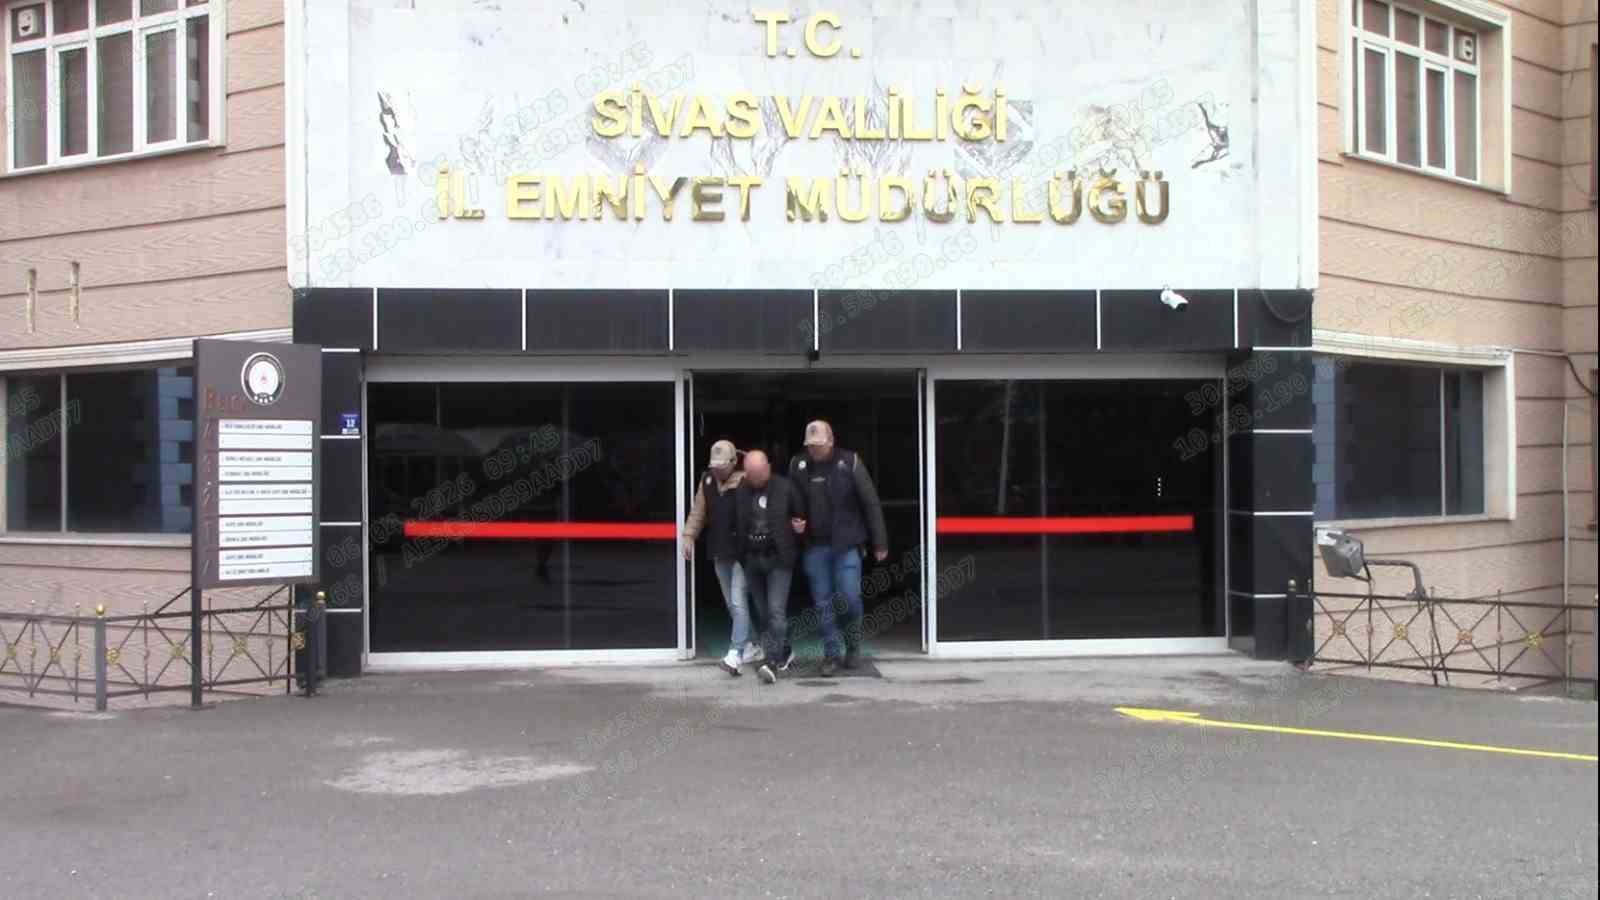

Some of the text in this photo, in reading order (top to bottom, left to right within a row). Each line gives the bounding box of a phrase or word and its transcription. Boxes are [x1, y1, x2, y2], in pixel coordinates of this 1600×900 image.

[752, 9, 863, 57] T.C.
[591, 80, 1008, 143] SİVAS VALİLİĞİ
[436, 160, 1170, 225] İL EMNİYET MÜDÜRLÜĞÜ
